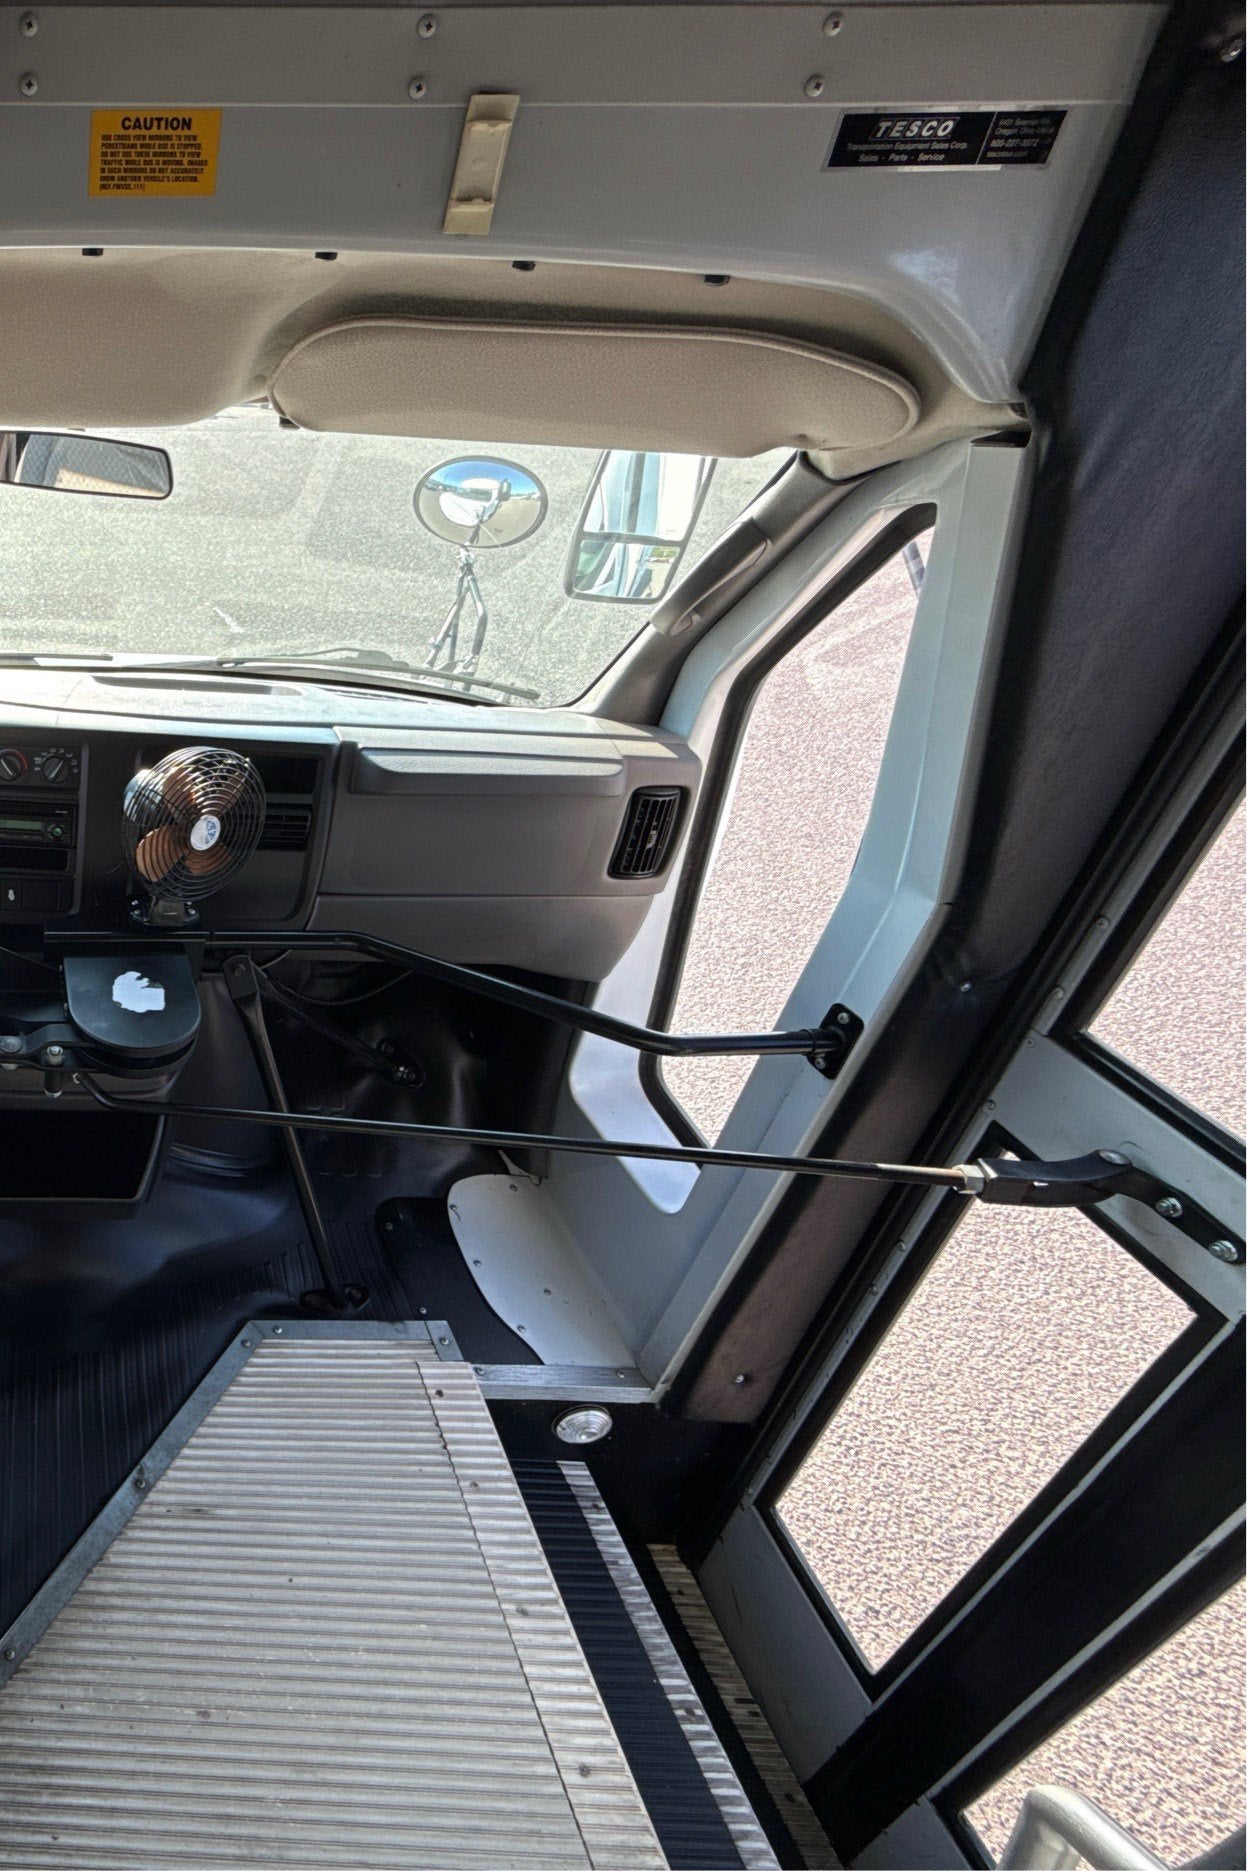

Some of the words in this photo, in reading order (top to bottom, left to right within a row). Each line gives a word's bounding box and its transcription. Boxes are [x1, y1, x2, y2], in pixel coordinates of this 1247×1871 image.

[121, 116, 192, 131] CAUTION
[875, 120, 955, 138] TESCO
[102, 134, 111, 142] USE
[114, 134, 131, 142] CROSS
[133, 134, 146, 142] VIEW
[149, 134, 174, 142] MIRRORS
[184, 134, 197, 142] VIEW
[101, 142, 137, 150] PEDESTRIANS
[140, 142, 155, 150] WHILE
[158, 142, 168, 150] BUS
[859, 153, 878, 162] Sales
[889, 153, 908, 162] Parts
[918, 152, 945, 162] Service
[107, 167, 121, 175] SUCH
[123, 167, 147, 175] MIRRORS
[158, 167, 168, 175] NOT
[170, 167, 204, 175] ACCURATELY
[100, 175, 115, 183] SHOW
[117, 175, 141, 183] ANOTHER
